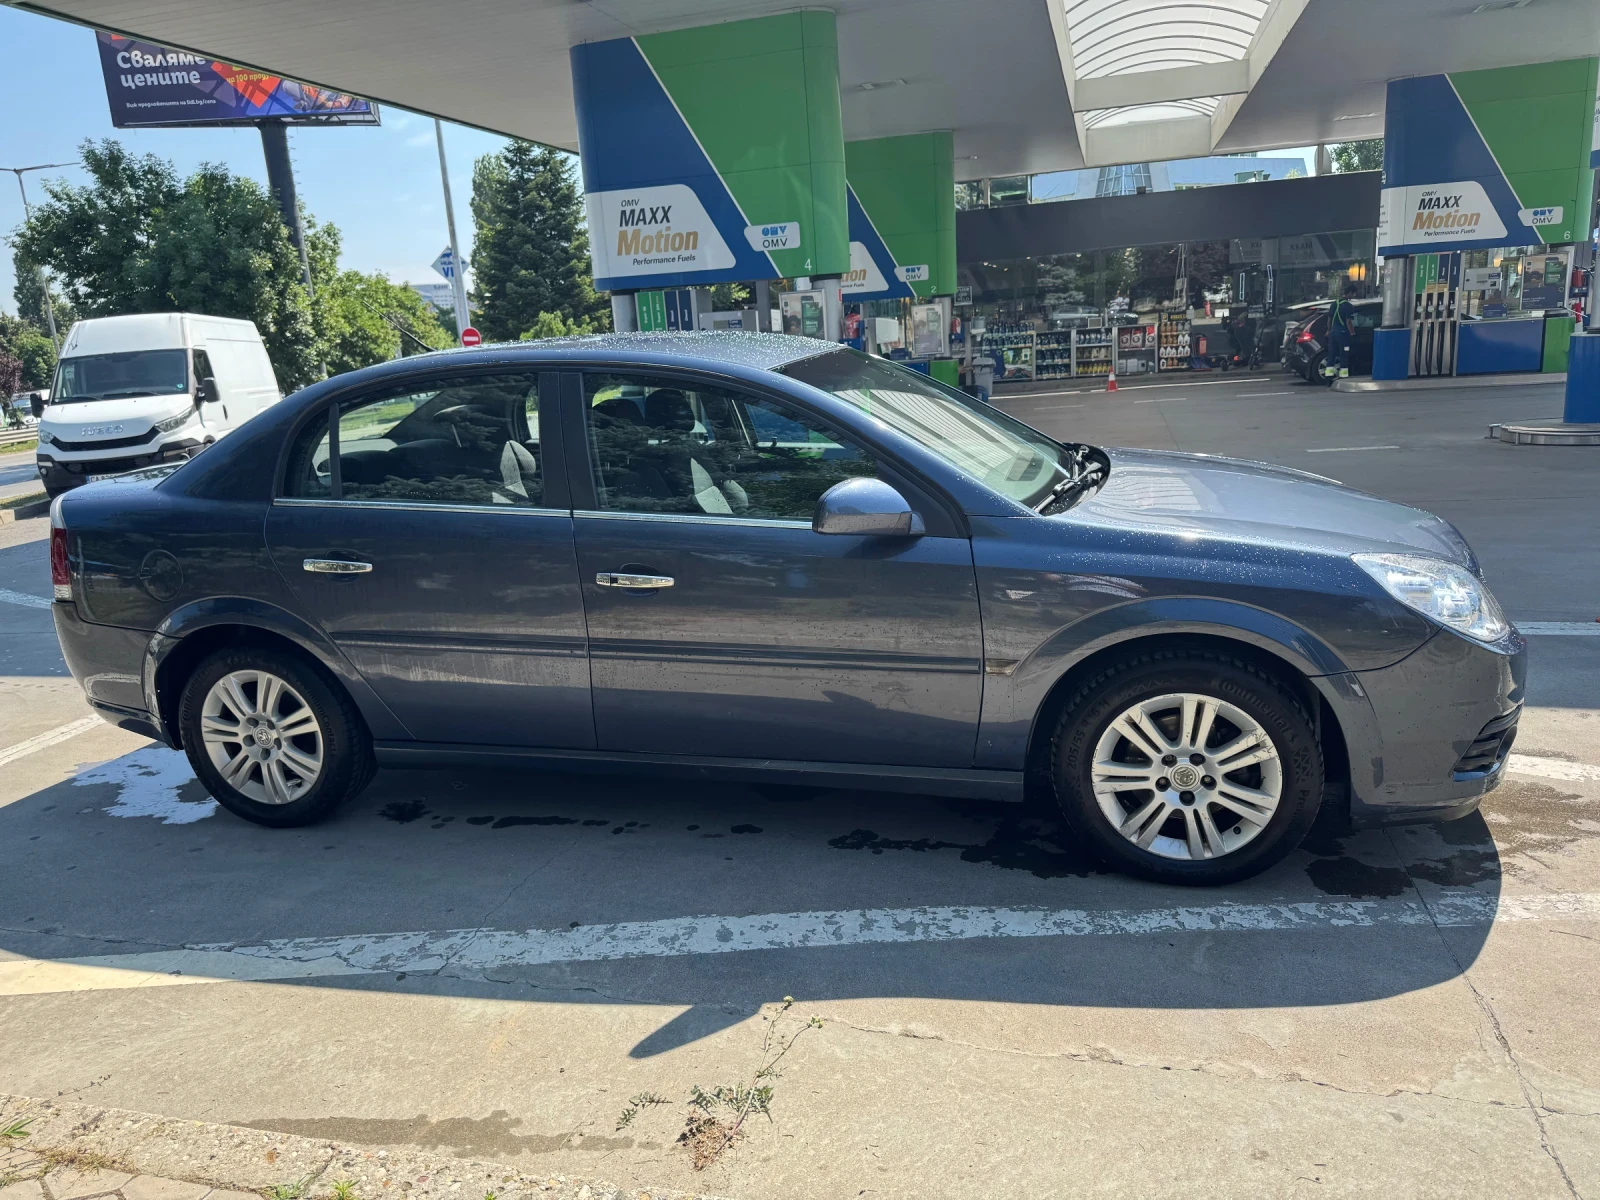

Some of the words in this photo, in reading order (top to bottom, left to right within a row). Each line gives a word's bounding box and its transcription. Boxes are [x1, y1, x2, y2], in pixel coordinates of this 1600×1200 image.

[120, 70, 201, 90] цените
[620, 199, 640, 207] OMV
[1417, 195, 1463, 211] MAXX
[619, 205, 672, 227] MAXX
[1412, 209, 1481, 230] Motion
[1531, 216, 1553, 225] OMV
[617, 226, 699, 256] Motion
[1563, 230, 1571, 240] 6
[762, 238, 788, 249] OMV
[632, 257, 676, 265] Performance
[677, 254, 696, 262] Fuels
[804, 258, 813, 271] 4
[82, 424, 123, 436] IVECO
[1066, 729, 1086, 770] 205/55
